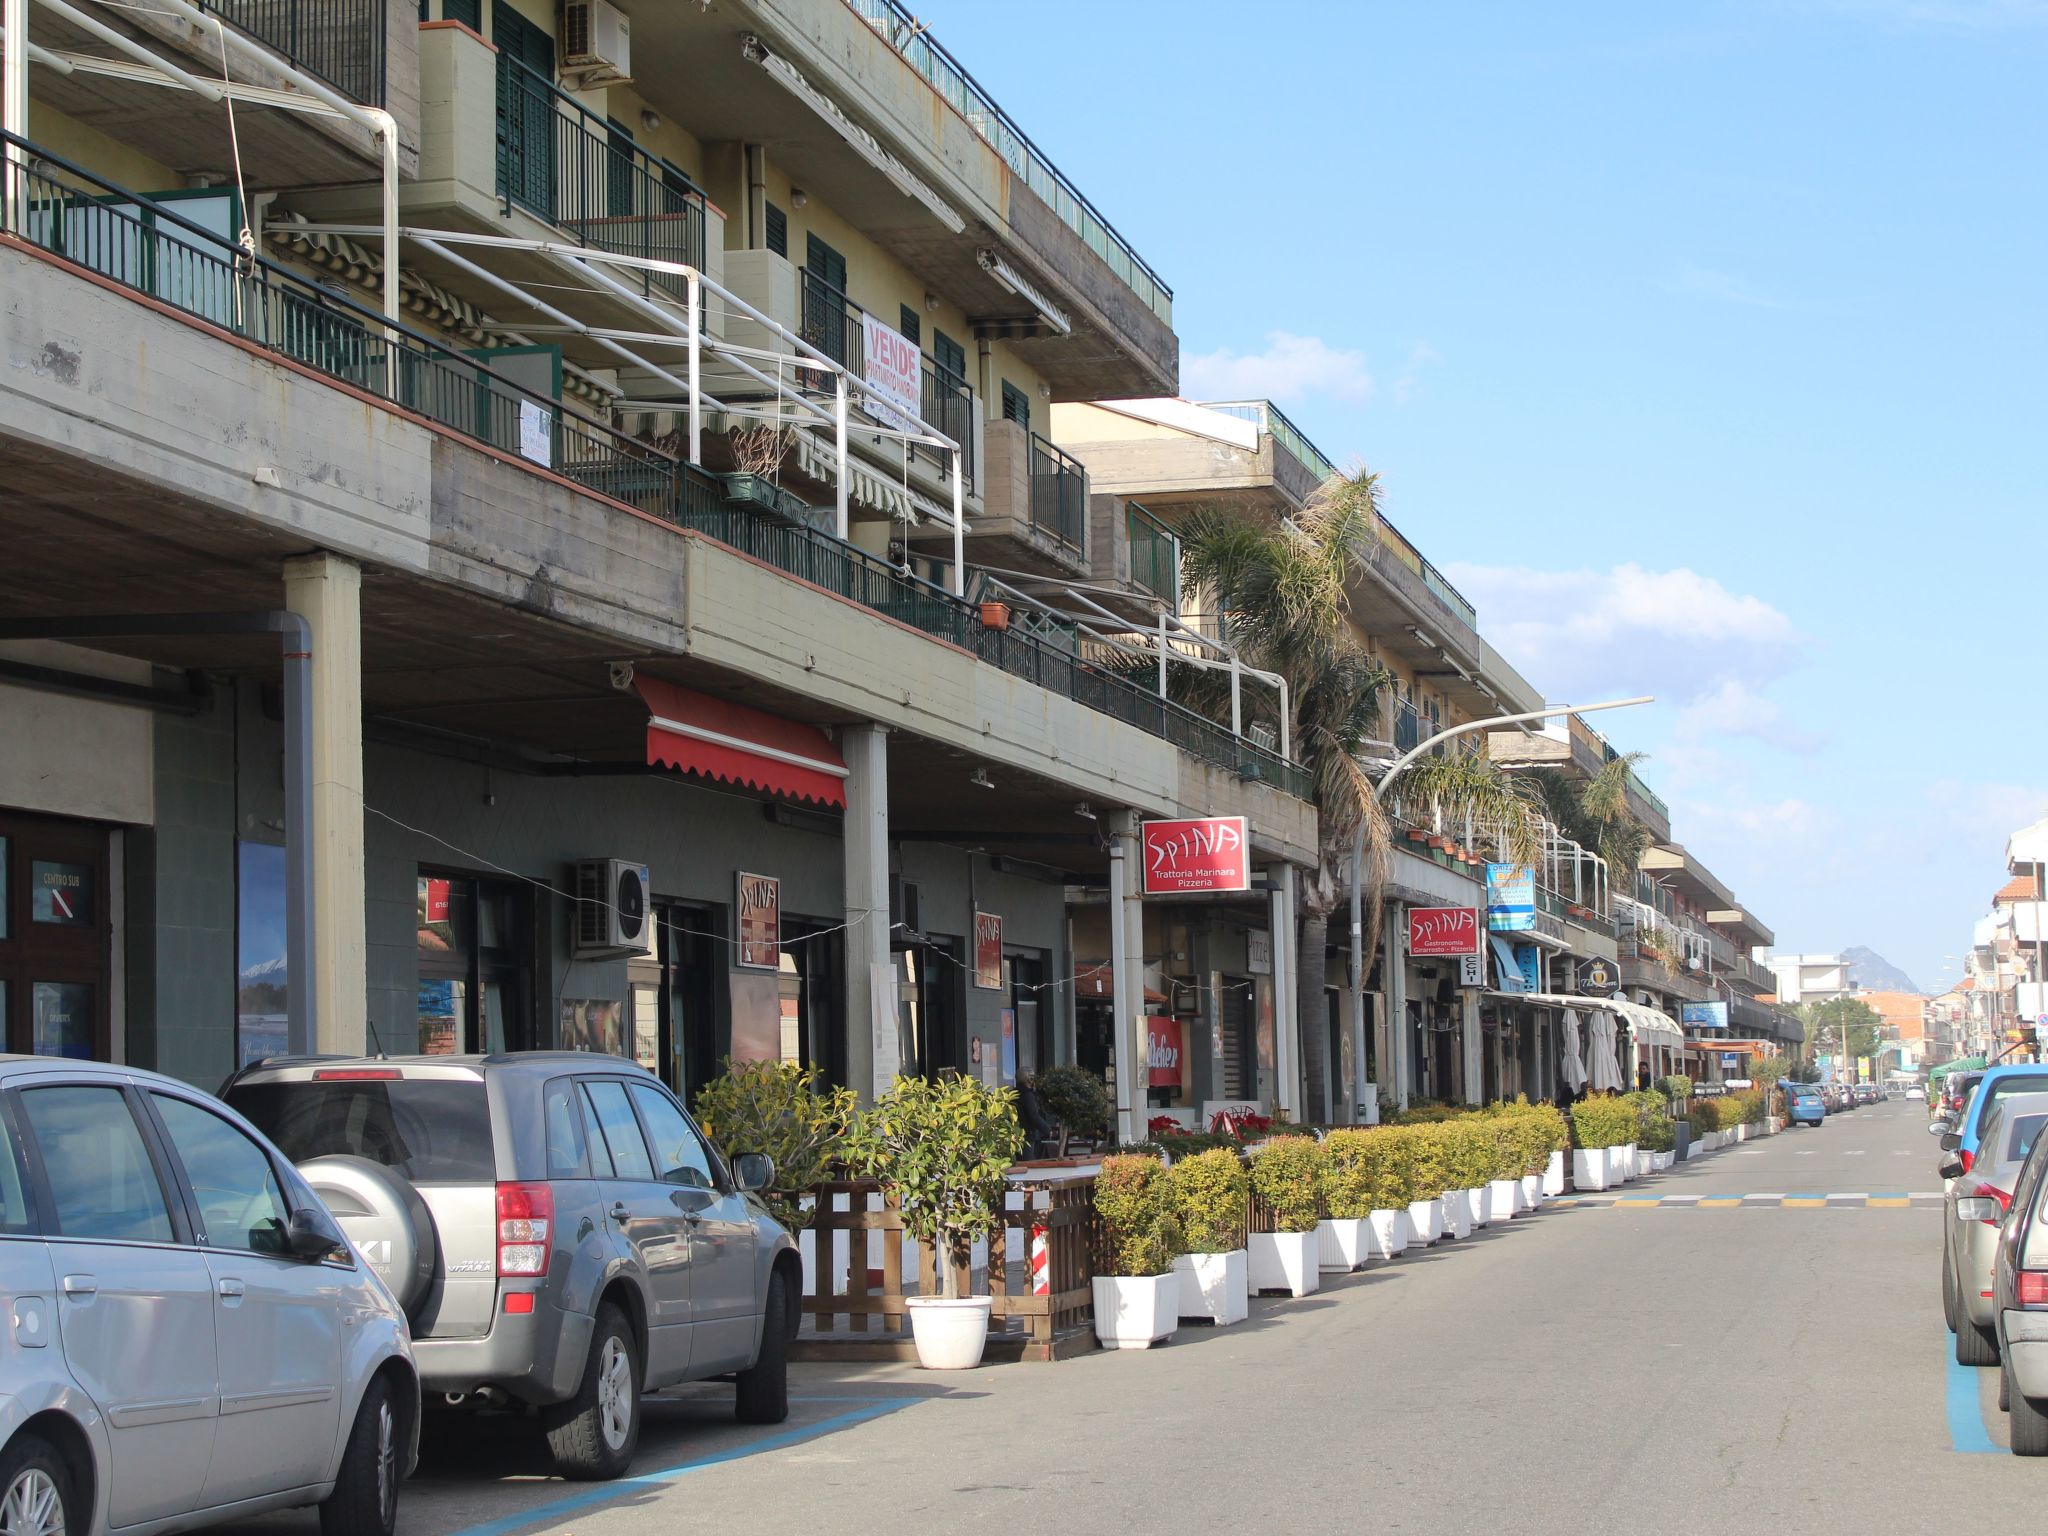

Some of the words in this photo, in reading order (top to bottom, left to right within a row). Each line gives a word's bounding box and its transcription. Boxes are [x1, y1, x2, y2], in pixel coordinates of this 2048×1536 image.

[869, 323, 916, 383] VENDE
[1147, 824, 1240, 871] SPINA
[43, 872, 67, 886] CENTRO
[68, 874, 80, 887] SUB
[1154, 870, 1193, 879] Trattoria
[1195, 868, 1236, 877] Marinara
[1177, 879, 1213, 888] Pizzeria
[740, 875, 776, 917] SPINA
[976, 917, 1000, 948] SPINA
[1411, 910, 1474, 941] SPINA
[1465, 956, 1477, 983] CCHI
[447, 1265, 492, 1273] VITARA
